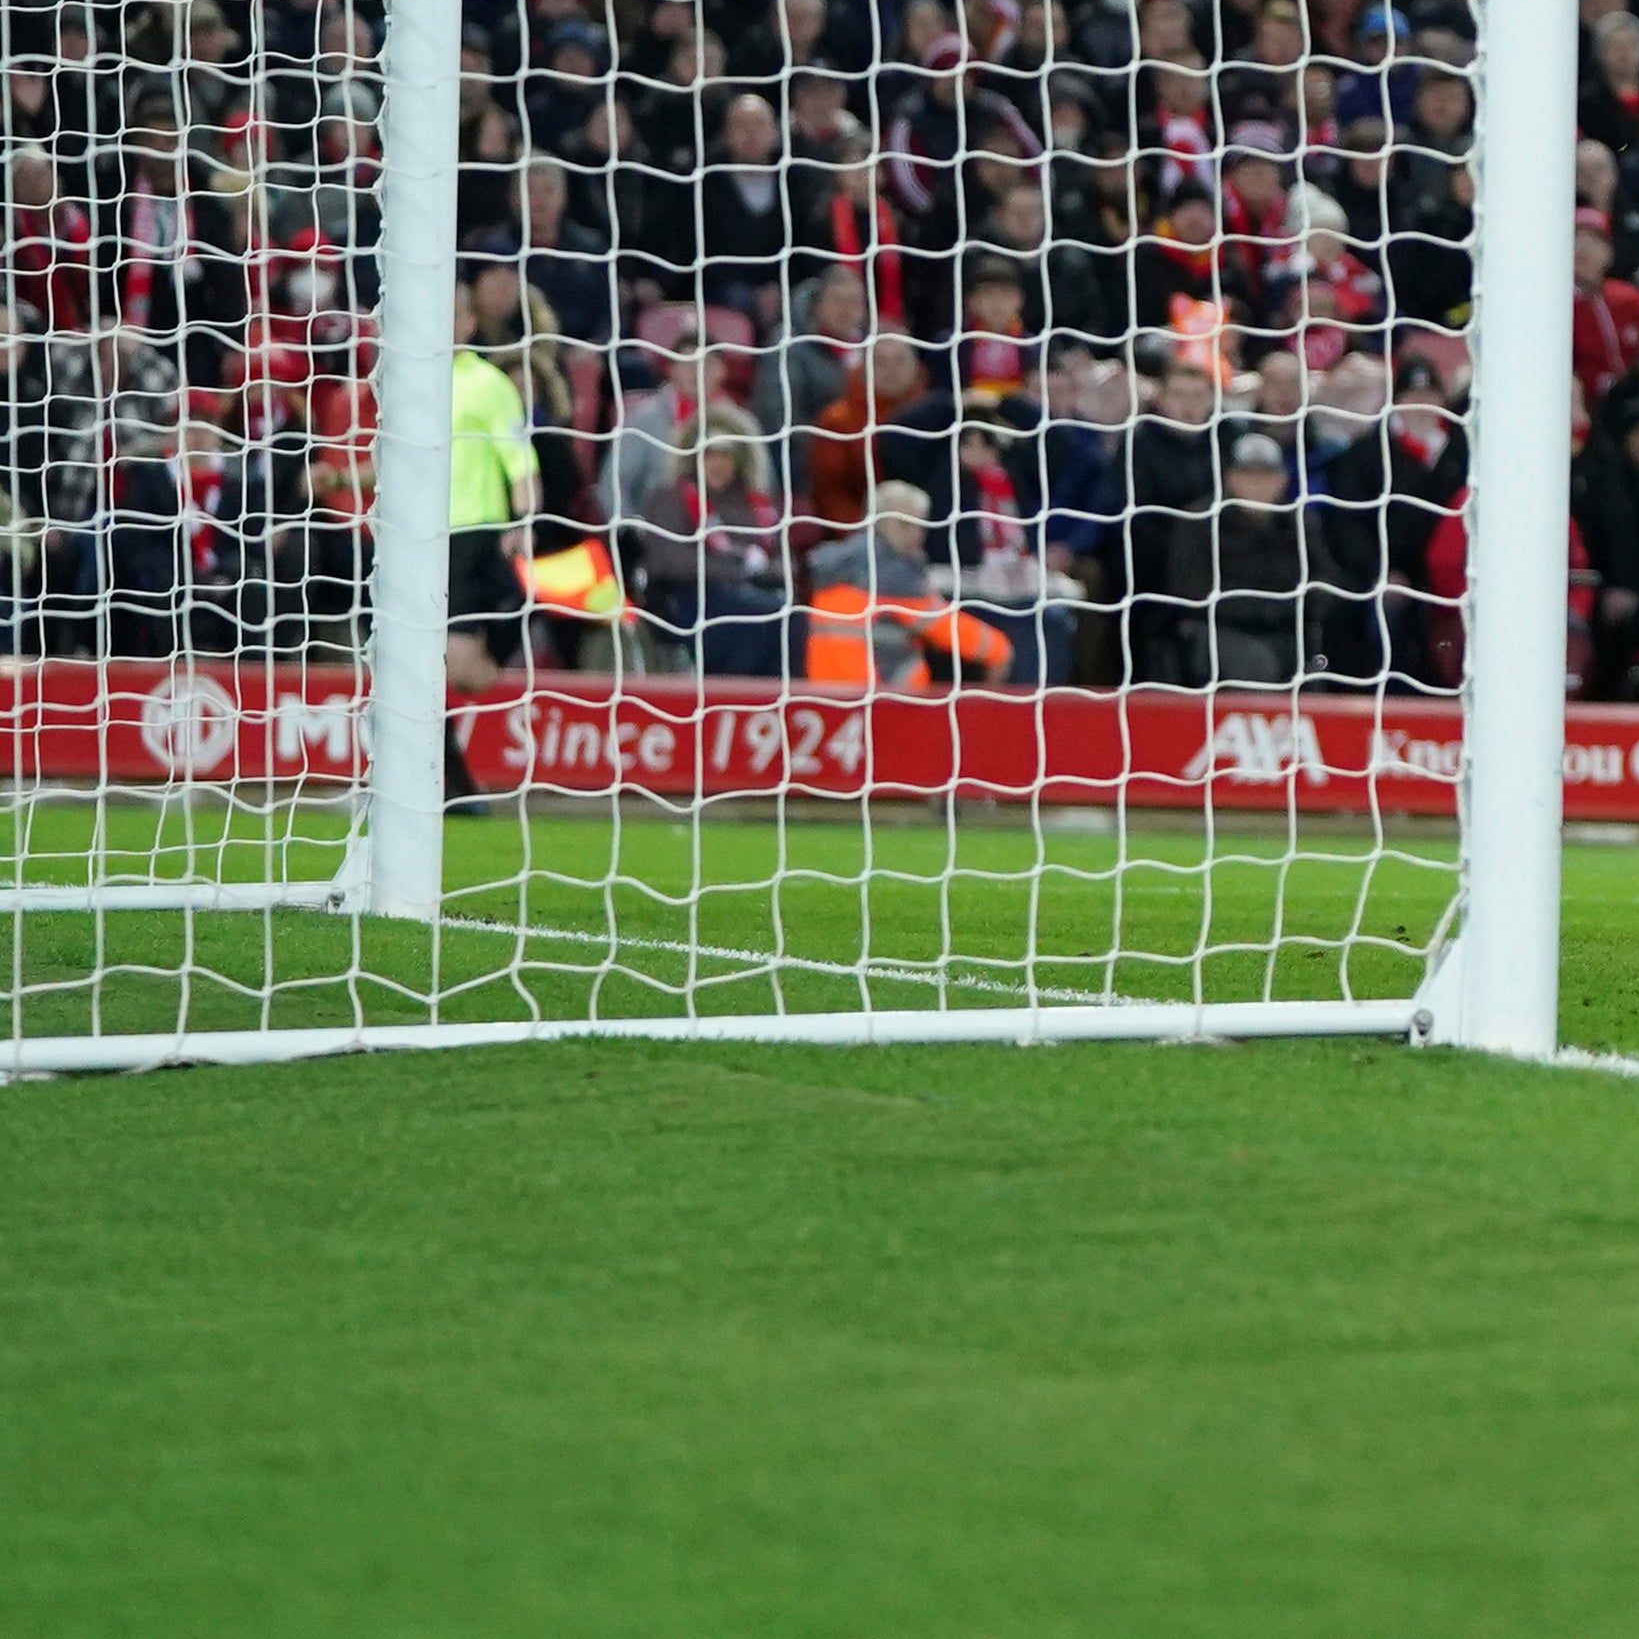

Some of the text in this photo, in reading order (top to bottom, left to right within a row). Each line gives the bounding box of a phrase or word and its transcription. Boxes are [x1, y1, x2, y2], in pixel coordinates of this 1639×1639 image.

[503, 703, 677, 773] Since
[710, 709, 864, 775] 1924
[1182, 712, 1329, 786] AXA
